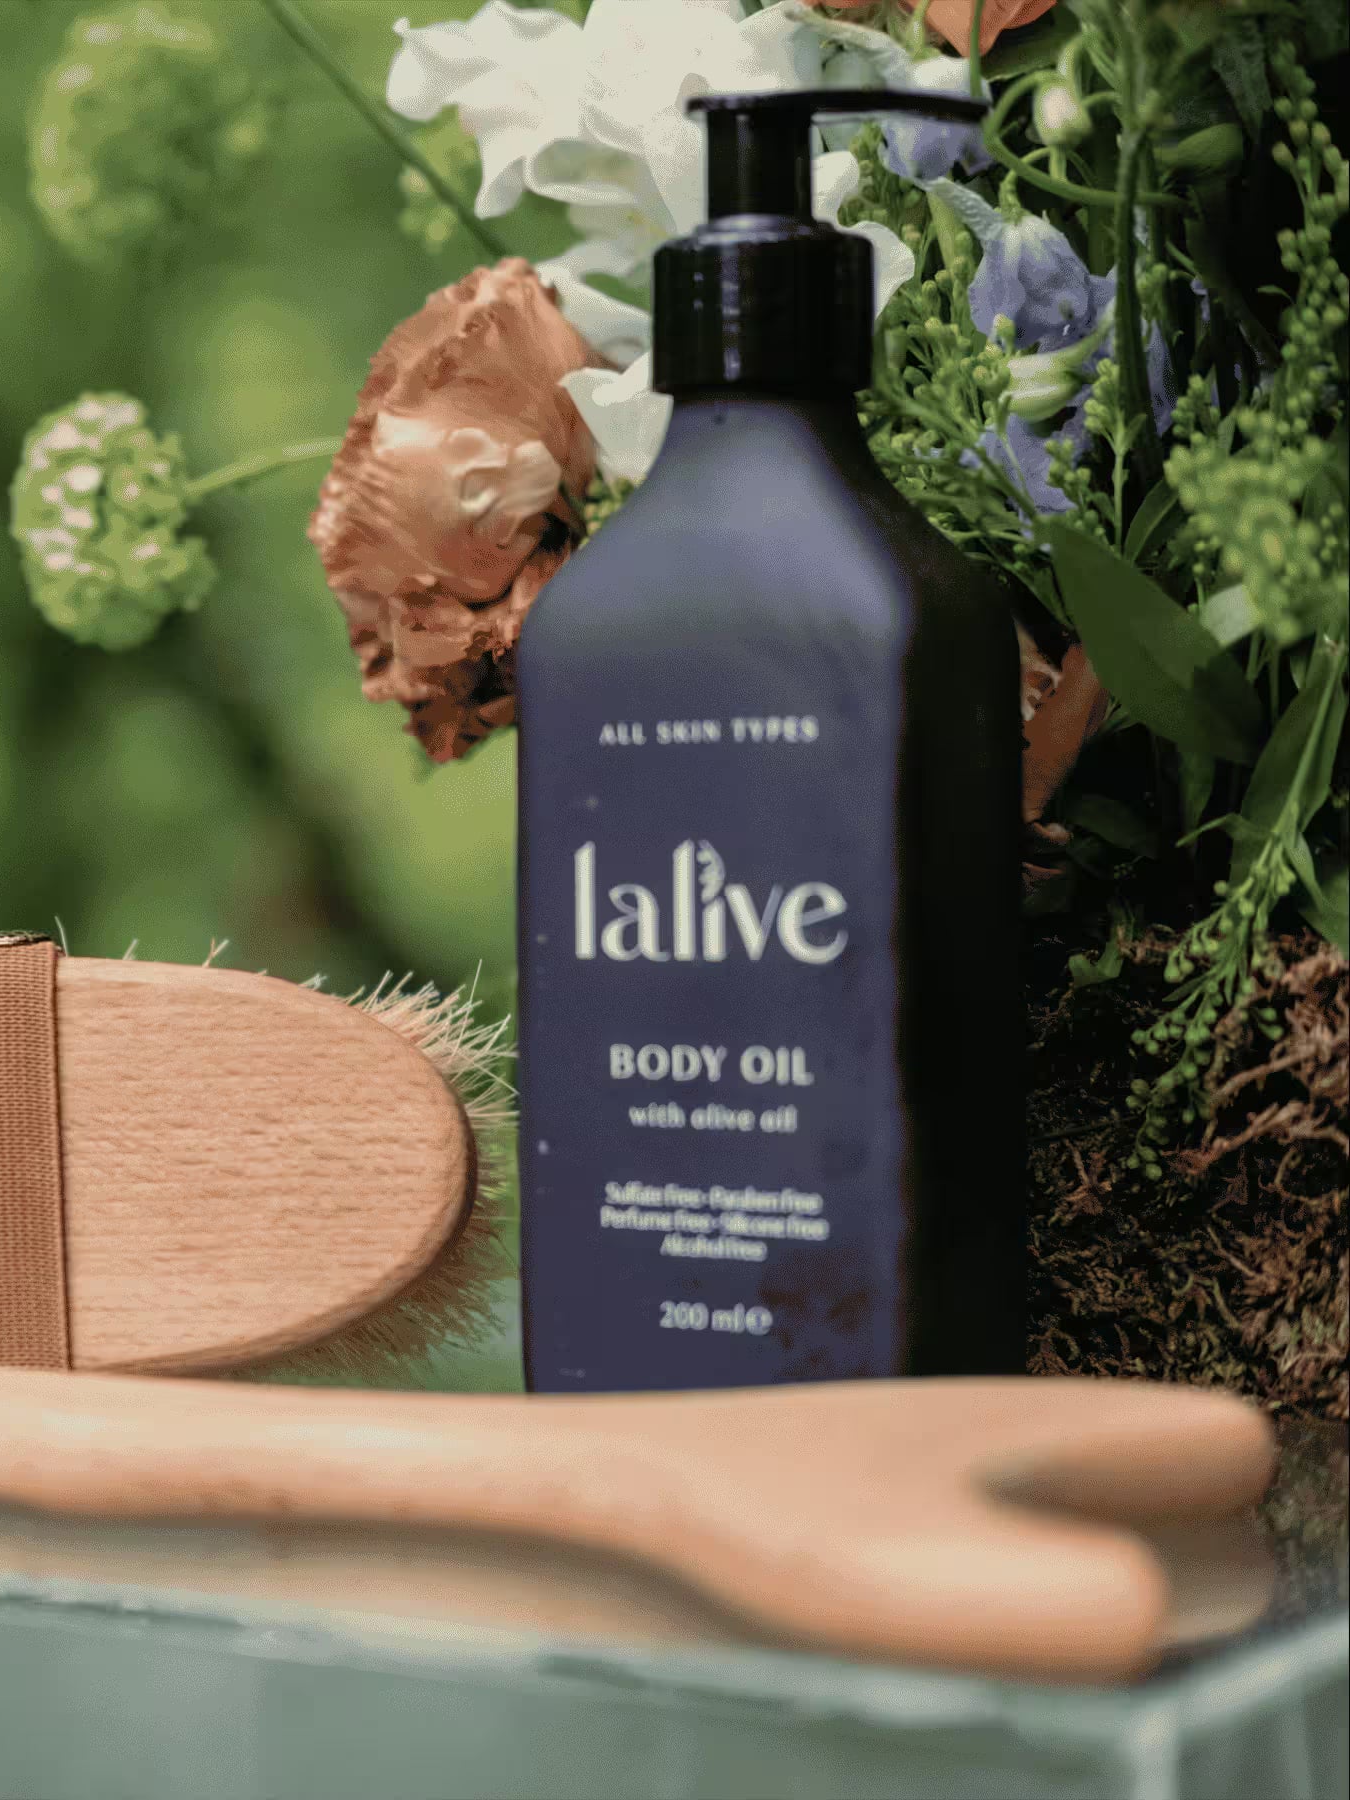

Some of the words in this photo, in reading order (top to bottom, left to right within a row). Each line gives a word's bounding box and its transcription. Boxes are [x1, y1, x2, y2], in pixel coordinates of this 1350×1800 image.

[600, 721, 646, 745] ALL
[656, 720, 721, 744] SKIN
[731, 715, 820, 742] TYPES
[574, 839, 849, 965] lalive
[609, 1044, 727, 1082] BODY
[740, 1045, 815, 1085] OIL
[629, 1102, 685, 1128] with
[690, 1103, 755, 1131] olive
[760, 1104, 798, 1133] oil
[660, 1300, 709, 1330] 200
